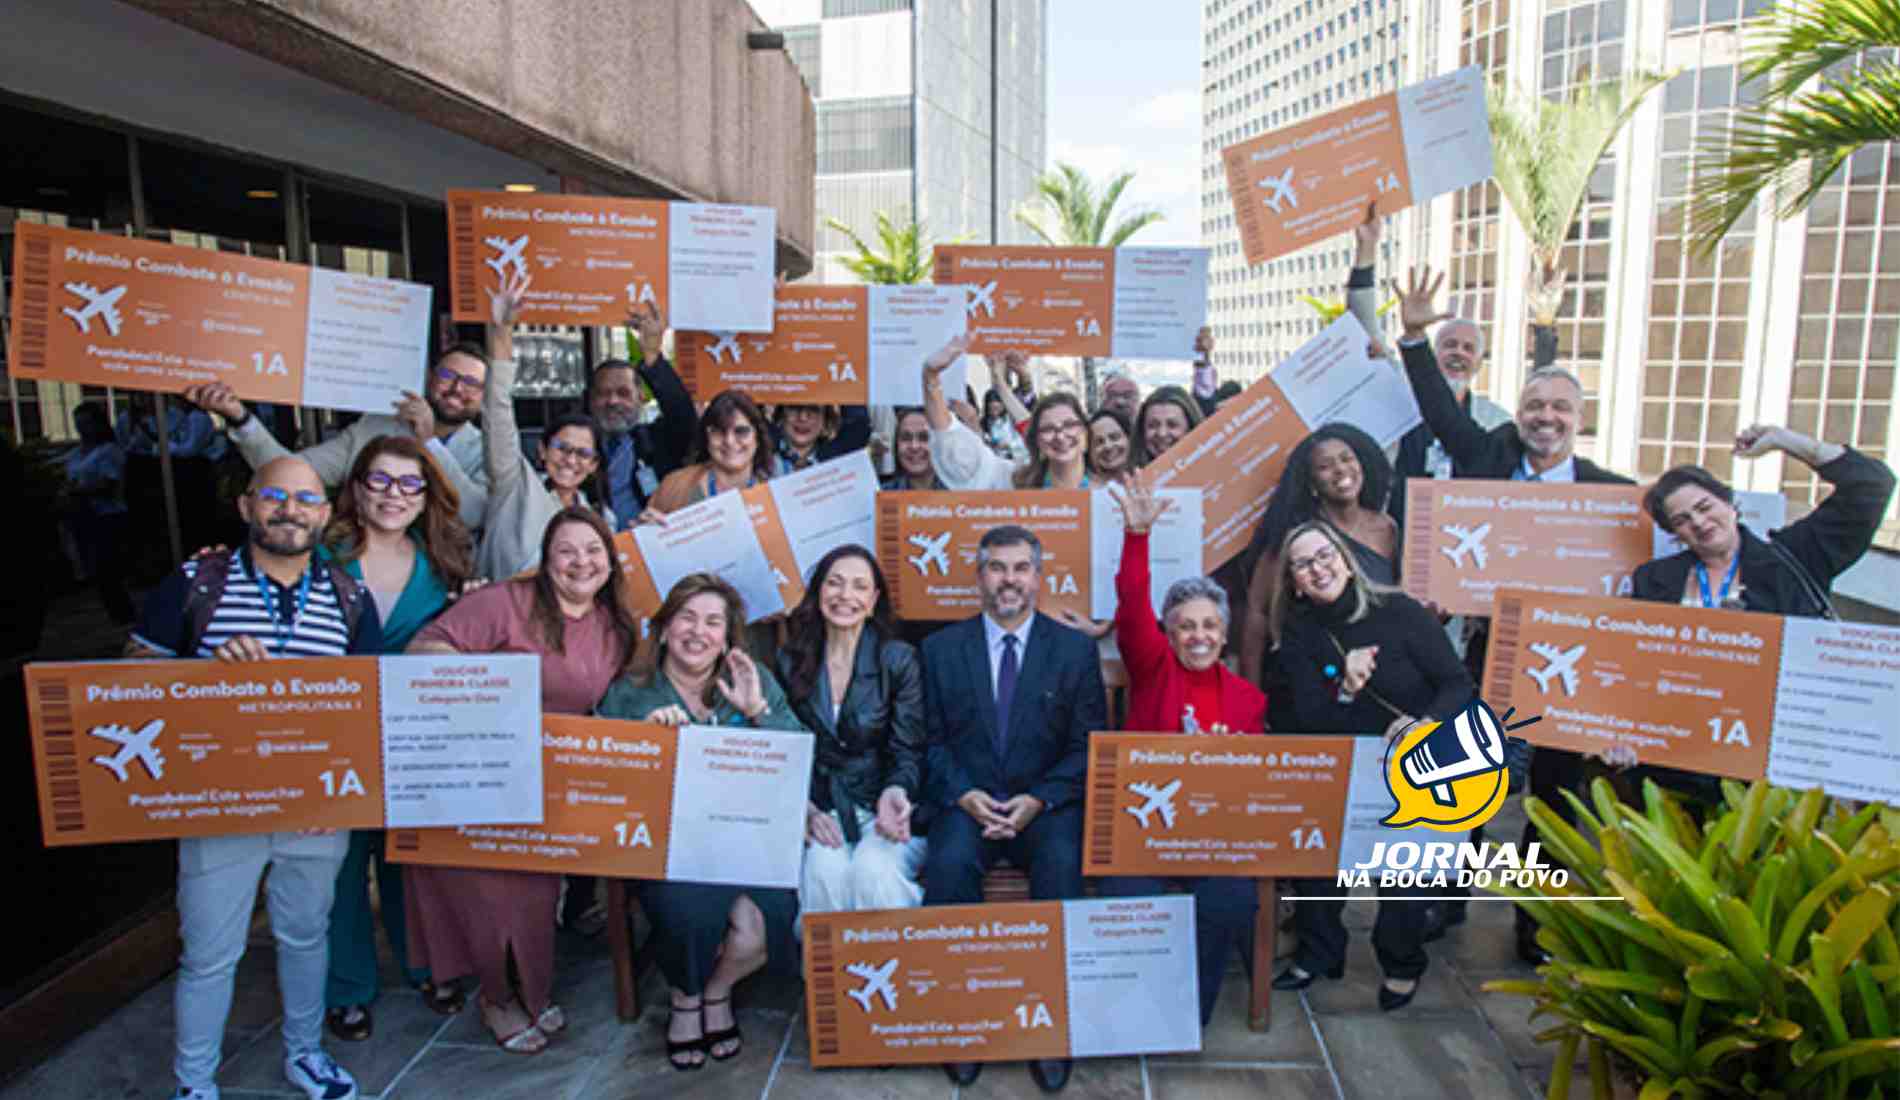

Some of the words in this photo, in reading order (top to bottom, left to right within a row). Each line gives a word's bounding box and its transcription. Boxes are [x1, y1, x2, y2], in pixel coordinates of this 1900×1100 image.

[252, 352, 289, 377] 1A
[827, 361, 858, 383] 1A
[1045, 574, 1079, 594] 1A
[1595, 615, 1677, 639] Combate
[86, 682, 166, 703] Prêmio
[169, 679, 267, 700] Combate
[289, 675, 362, 696] Evasão
[1707, 717, 1751, 748] 1A
[319, 768, 367, 798] 1A
[613, 821, 653, 849] 1A
[1289, 827, 1325, 850] 1A
[1014, 1001, 1054, 1029] 1A
